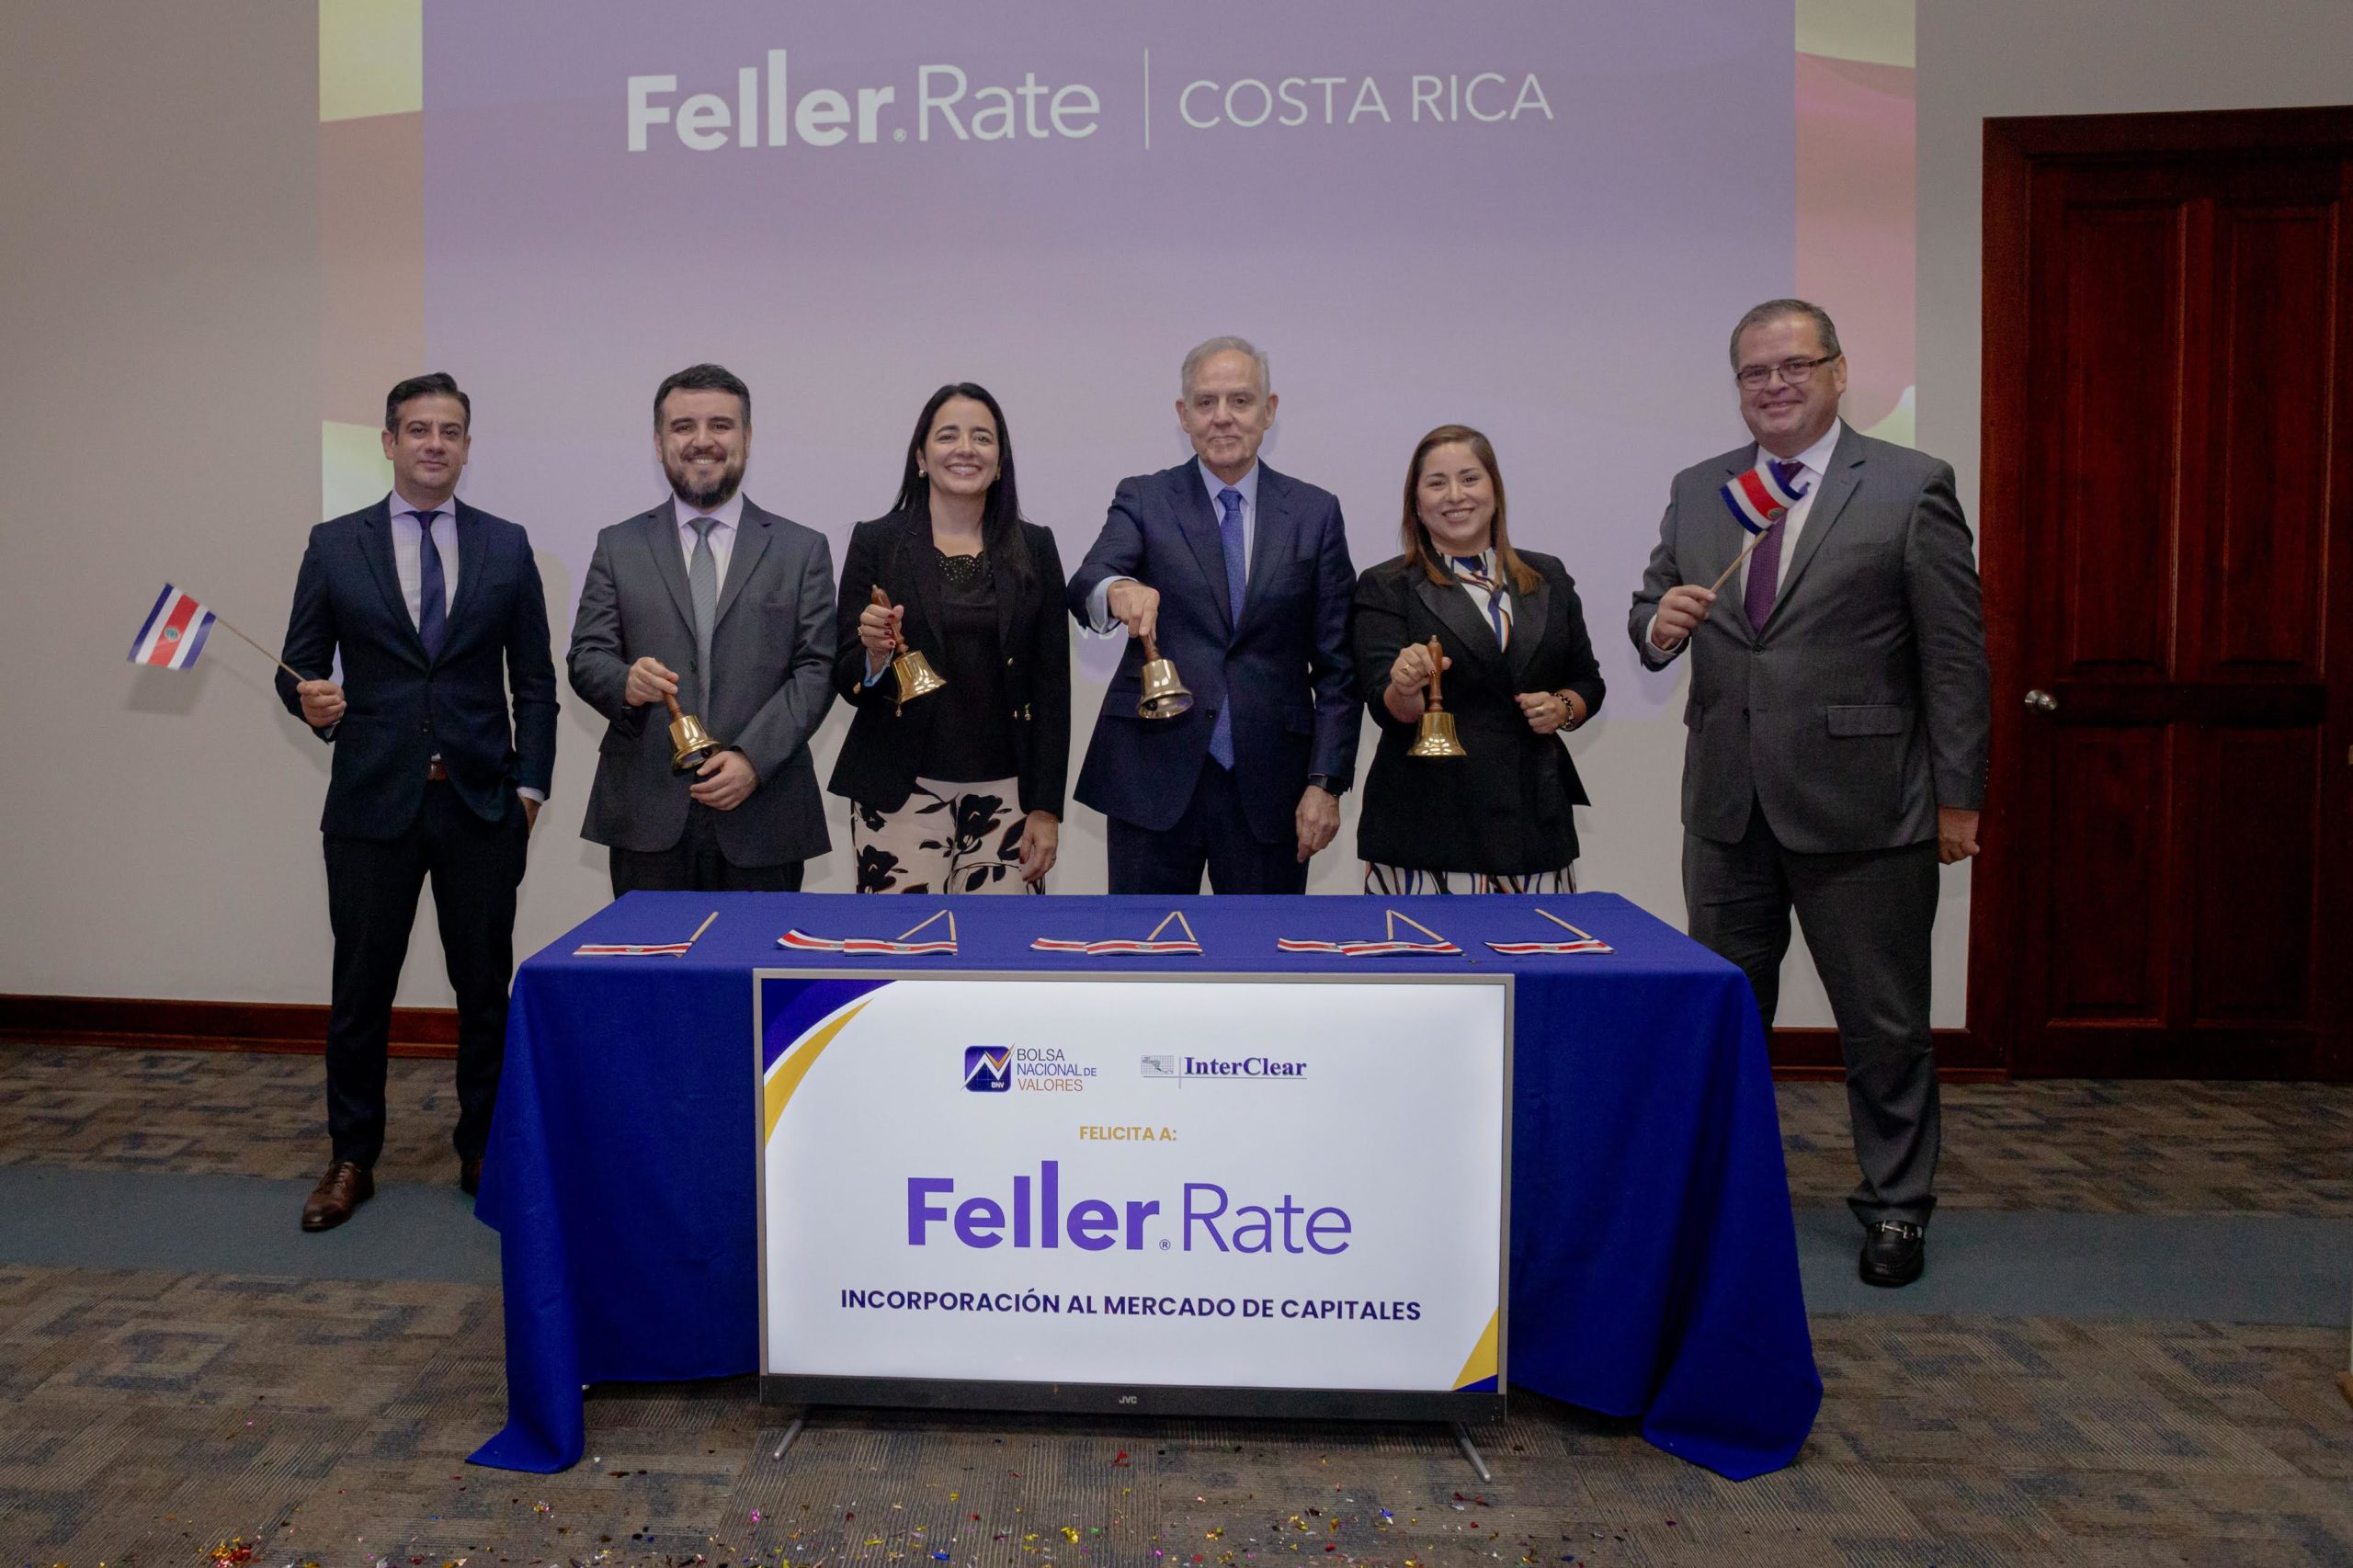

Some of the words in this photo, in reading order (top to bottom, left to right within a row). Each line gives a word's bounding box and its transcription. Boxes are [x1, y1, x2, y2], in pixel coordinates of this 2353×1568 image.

[919, 64, 1100, 141] Rate
[1179, 76, 1391, 128] COSTA
[1412, 73, 1553, 122] RICA
[1017, 1049, 1065, 1062] BOLSA
[1017, 1063, 1083, 1076] NACIONAL
[1084, 1068, 1097, 1076] DE
[1184, 1056, 1308, 1076] InterClear
[991, 1081, 1005, 1089] BNV
[1017, 1078, 1084, 1092] VALORES
[1080, 1126, 1155, 1142] FELICITA
[1158, 1127, 1177, 1142] A:
[1184, 1183, 1352, 1256] Rate
[841, 1288, 1060, 1313] INCORPORACIÓN
[1067, 1295, 1097, 1314] AL
[1104, 1295, 1236, 1317] MERCADO
[1242, 1298, 1274, 1318] DE
[1281, 1299, 1421, 1321] CAPITALES
[1119, 1395, 1137, 1404] JVC
